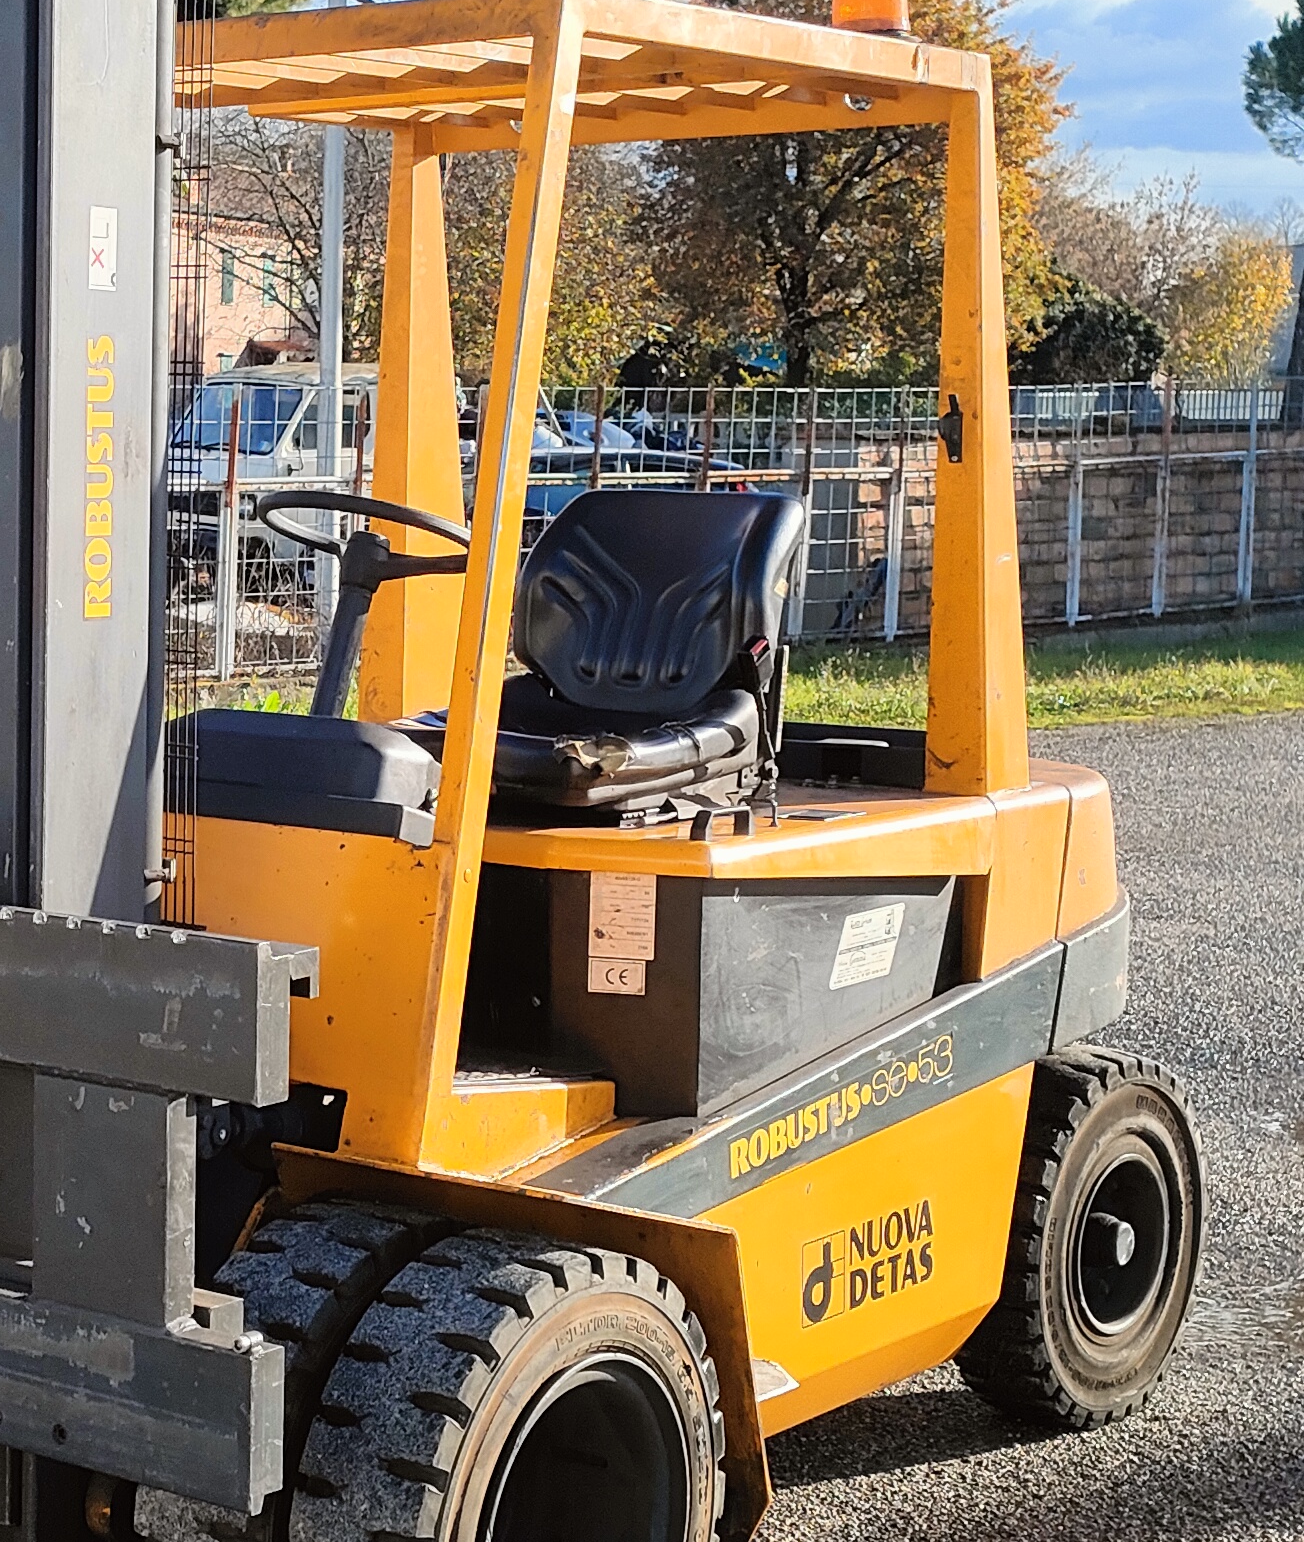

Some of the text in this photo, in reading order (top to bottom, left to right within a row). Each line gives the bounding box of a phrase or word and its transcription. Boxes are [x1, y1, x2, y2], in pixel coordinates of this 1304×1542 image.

[83, 334, 115, 620] ROBUSTUS
[605, 967, 629, 986] CE
[849, 1199, 934, 1265] NUOVA
[849, 1242, 934, 1310] DETAS
